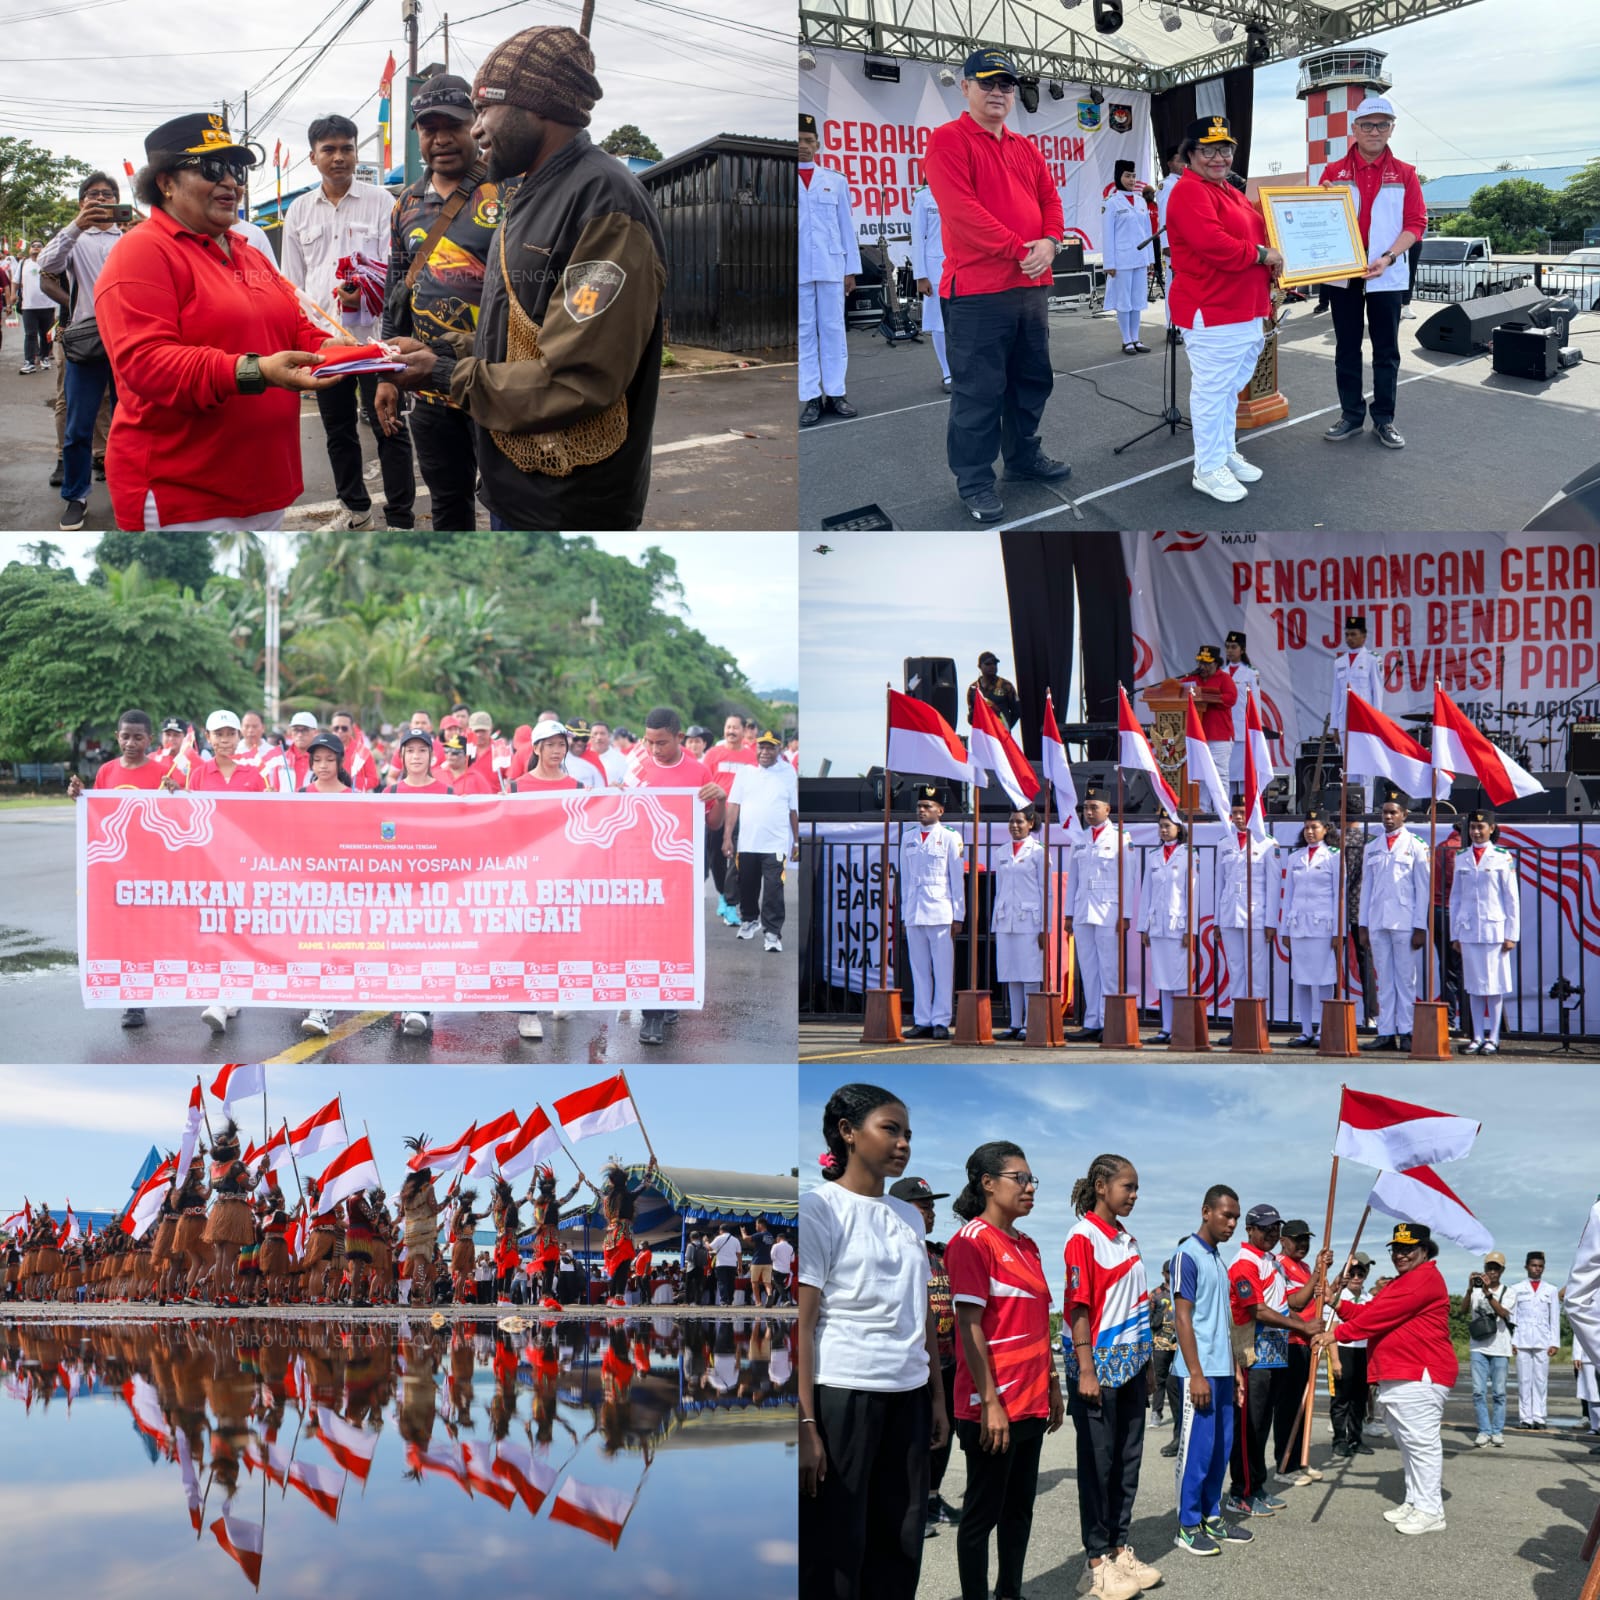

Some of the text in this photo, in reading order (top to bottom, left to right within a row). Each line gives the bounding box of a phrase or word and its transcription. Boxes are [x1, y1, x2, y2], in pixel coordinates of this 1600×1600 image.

[823, 119, 936, 154] GERAKA
[1221, 534, 1257, 545] MAJU
[1232, 543, 1600, 605] PENCANANGAN GERA
[1269, 607, 1307, 651] 10
[1427, 594, 1593, 645] BENDERA
[1336, 642, 1600, 694] OVINSI PAP
[250, 856, 528, 872] JALAN SANTAI DAN YOSPAN JALAN
[116, 879, 665, 907] GERAKAN PEMBAGIAN 10 JUTA BENDERA
[199, 907, 582, 934] DI PROVINSI PAPUA TENGAH
[332, 941, 366, 950] AGUSTUS
